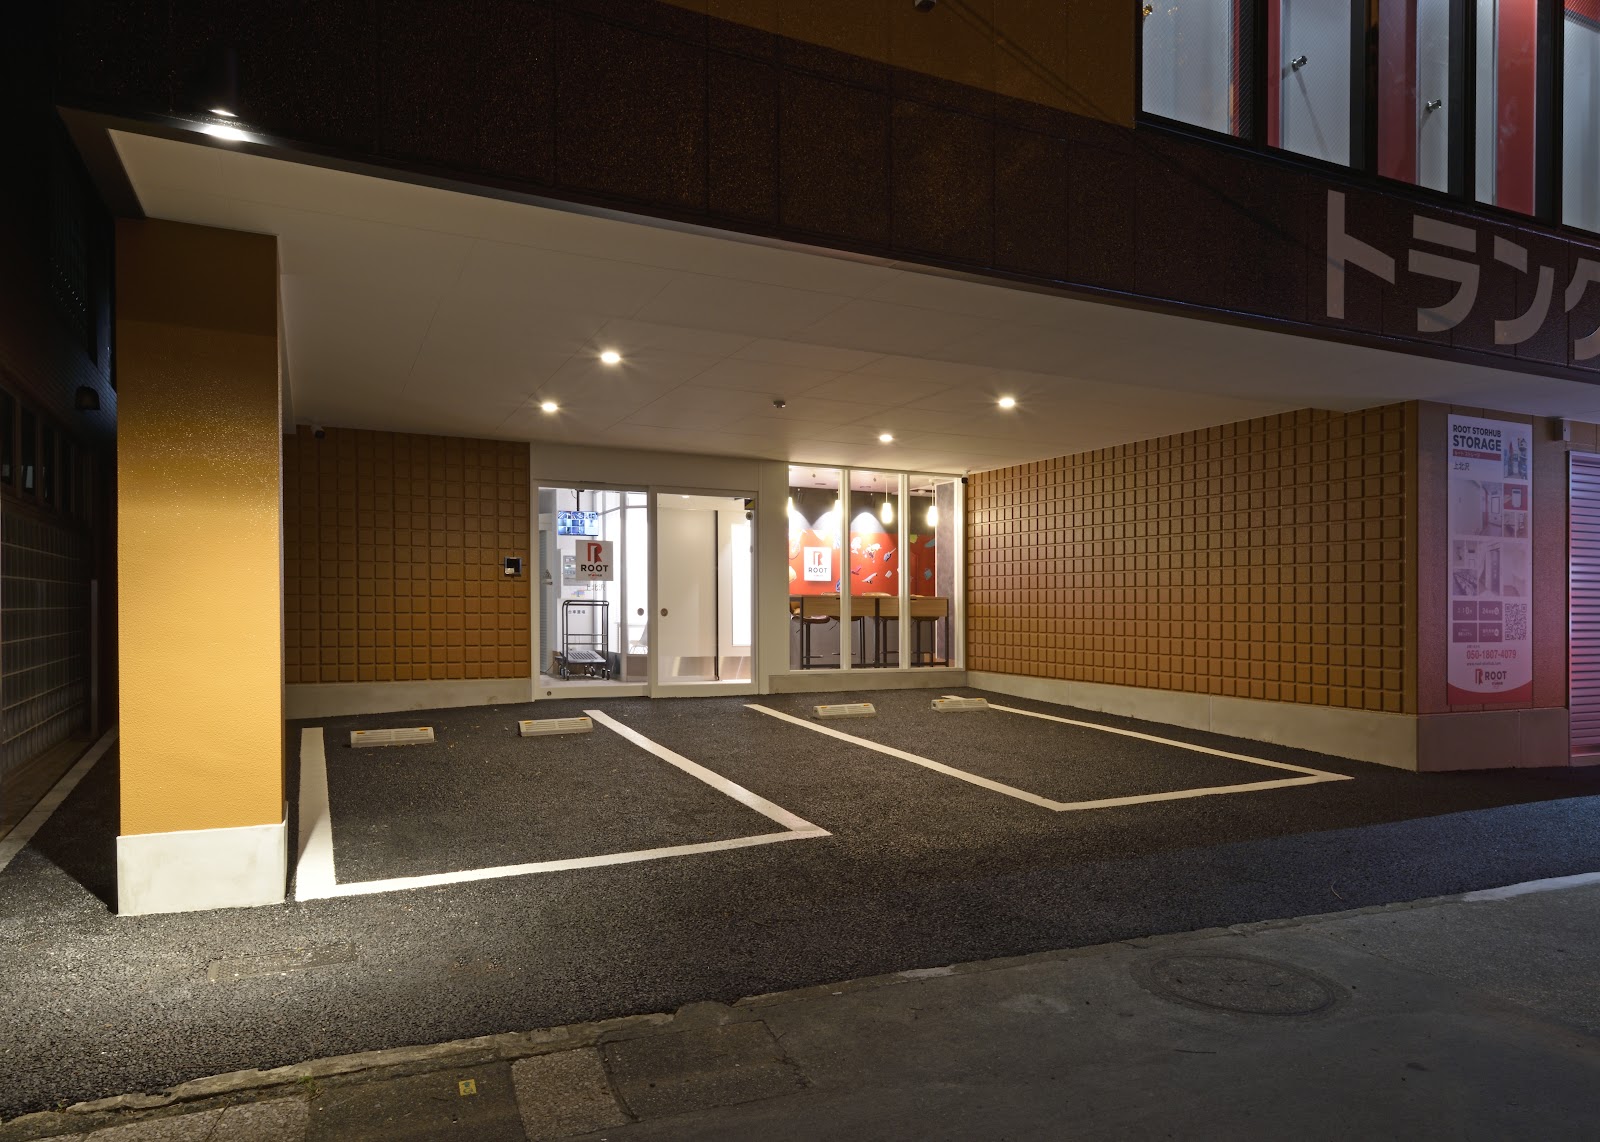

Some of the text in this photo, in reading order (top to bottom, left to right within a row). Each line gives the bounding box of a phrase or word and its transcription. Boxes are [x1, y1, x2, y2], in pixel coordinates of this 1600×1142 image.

[1453, 424, 1501, 437] ROOT STORHUB
[1453, 435, 1501, 451] STORAGE
[580, 564, 609, 572] ROOT
[808, 566, 828, 574] ROOT
[1466, 650, 1516, 659] 050-1807-4079
[1484, 670, 1507, 681] ROOT
